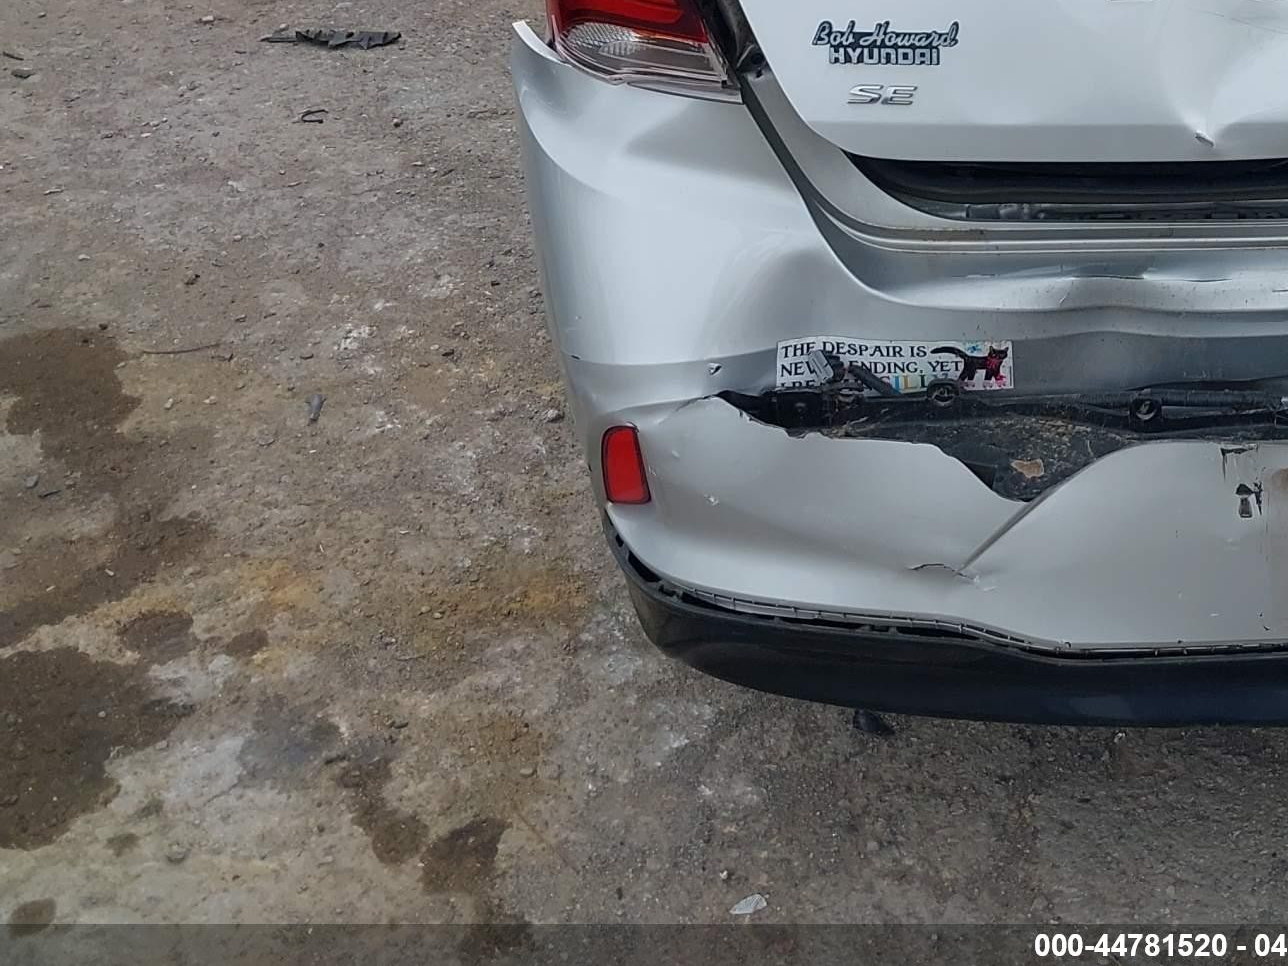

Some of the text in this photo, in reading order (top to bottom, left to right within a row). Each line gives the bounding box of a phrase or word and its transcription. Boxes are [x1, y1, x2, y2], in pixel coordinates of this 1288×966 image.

[812, 19, 961, 47] Bob Howard
[830, 47, 941, 65] HYUNDAI
[847, 84, 918, 106] SE
[781, 340, 928, 359] THE DESPAIR IS
[928, 360, 963, 373] YET
